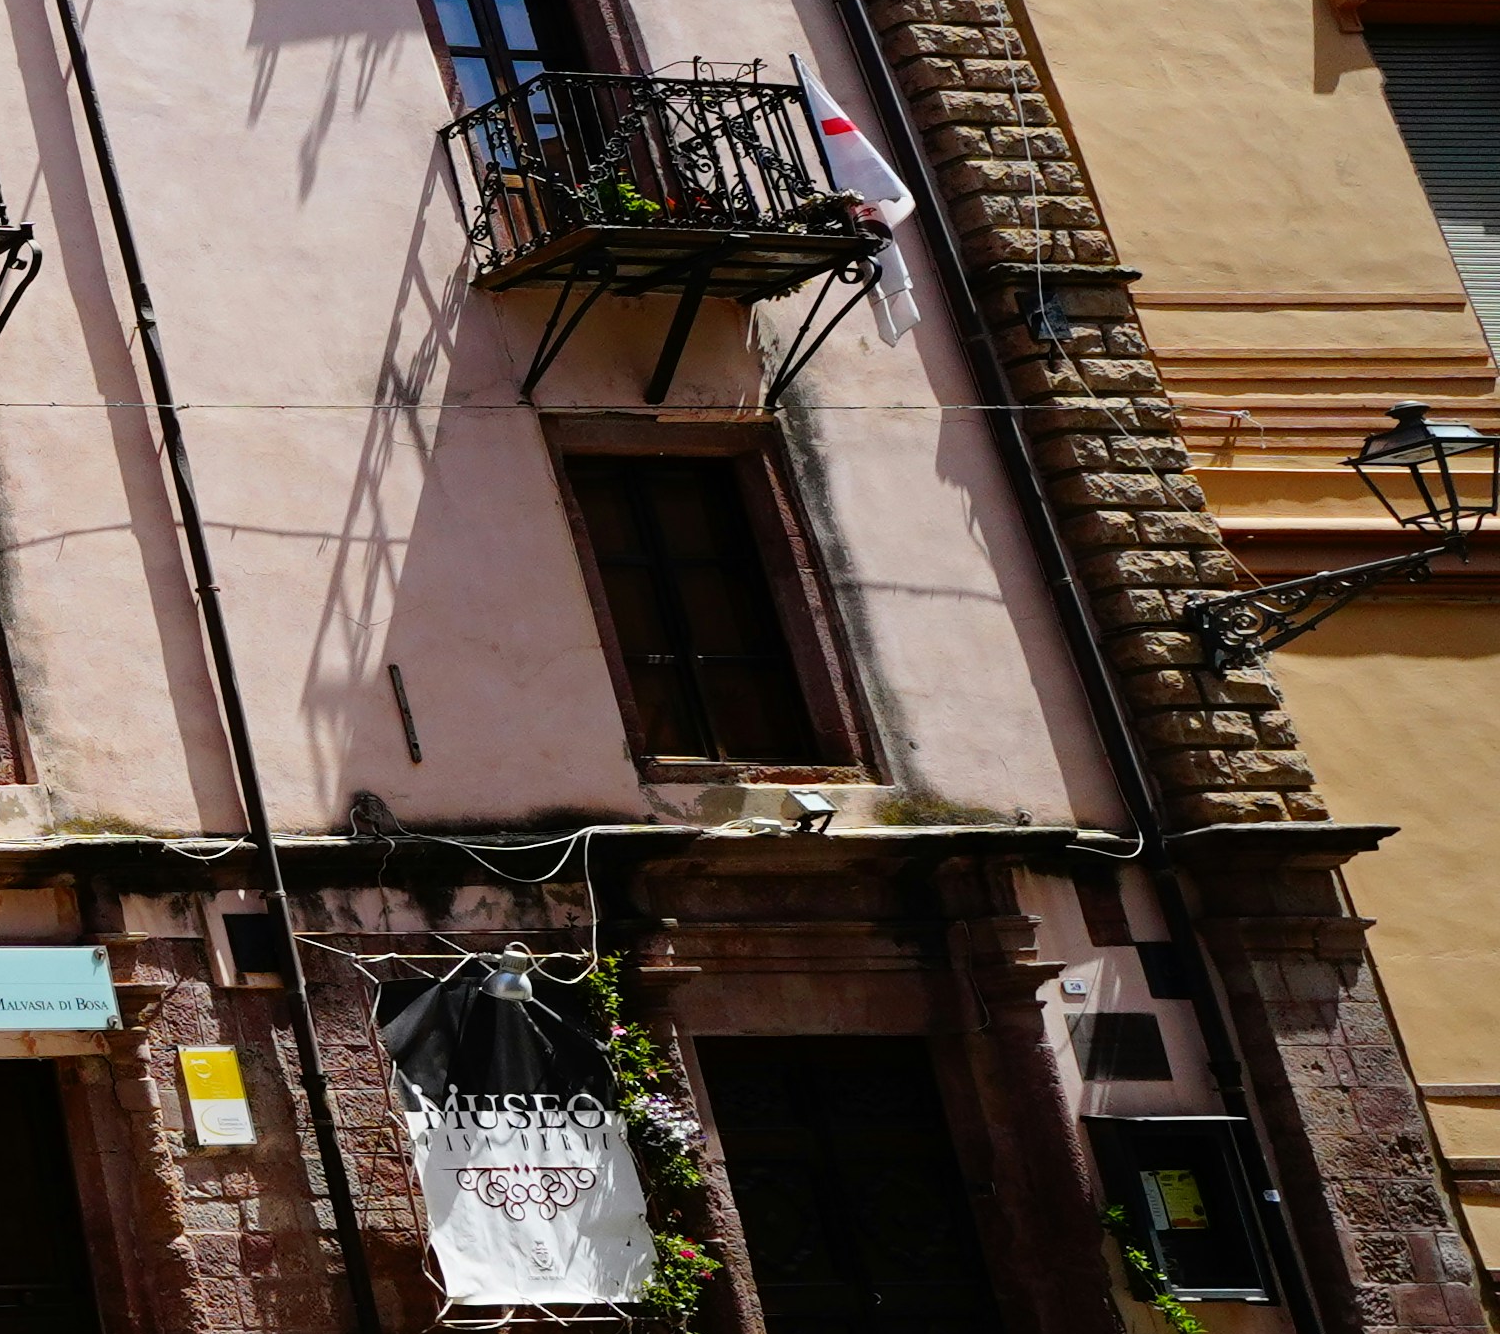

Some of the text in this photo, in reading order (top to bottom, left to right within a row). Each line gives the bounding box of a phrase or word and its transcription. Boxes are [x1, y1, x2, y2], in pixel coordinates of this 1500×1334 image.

[59, 1000, 72, 1011] DI
[75, 997, 109, 1011] BOSA
[411, 1083, 606, 1130] MUSEO
[425, 1133, 493, 1152] CASA
